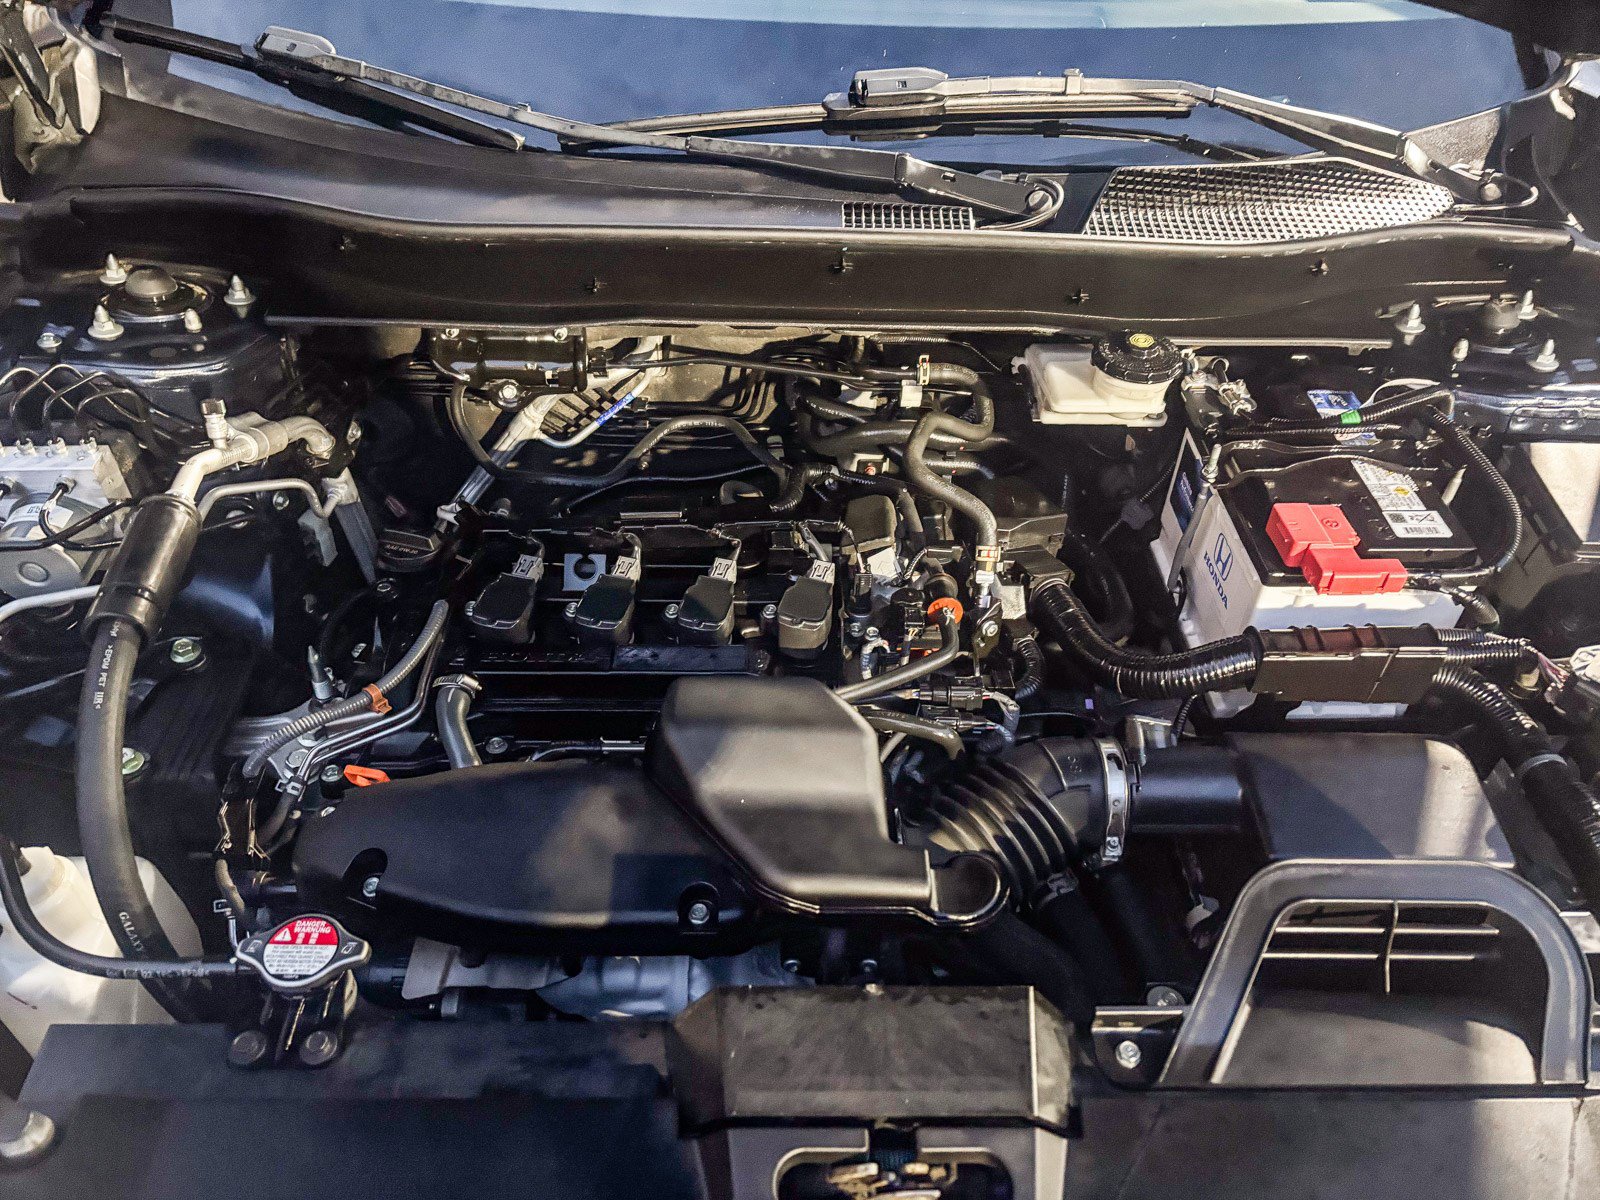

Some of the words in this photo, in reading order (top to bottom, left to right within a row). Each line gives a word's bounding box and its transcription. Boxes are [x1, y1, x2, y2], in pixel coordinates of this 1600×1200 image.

[1203, 550, 1228, 610] HONDA
[98, 672, 108, 688] PET
[293, 926, 331, 934] WARNUNG
[295, 920, 327, 928] DANGER
